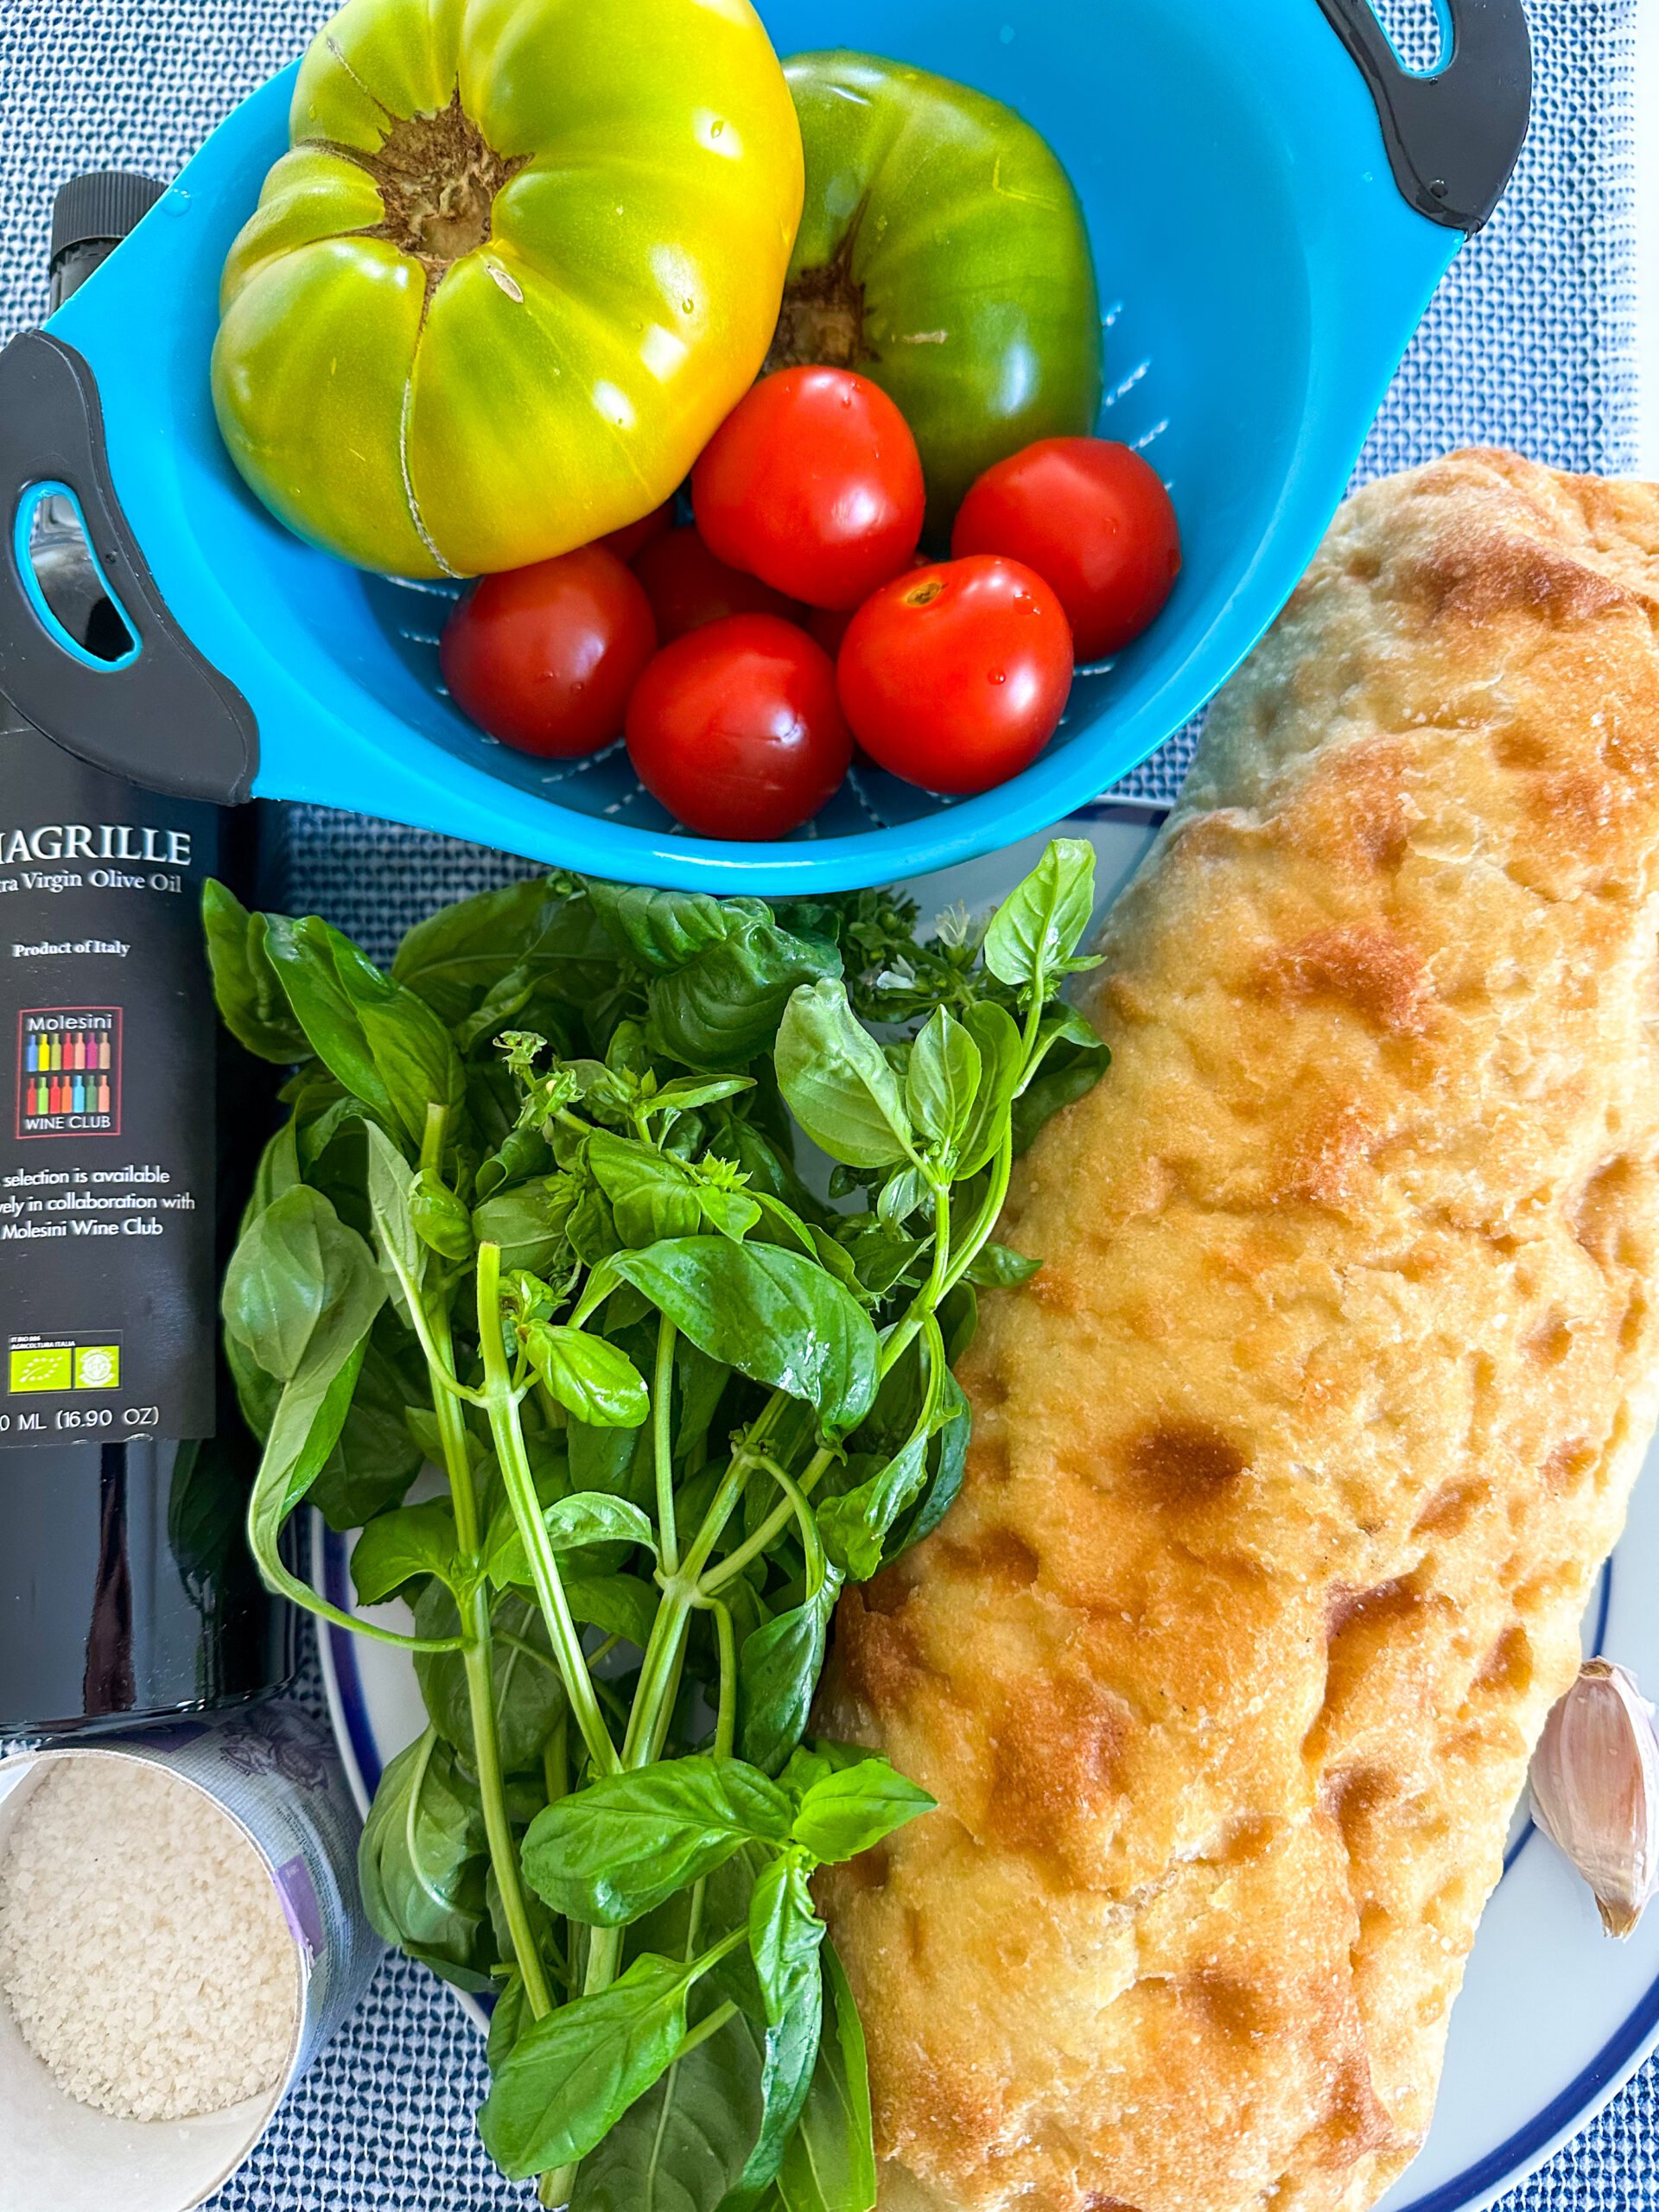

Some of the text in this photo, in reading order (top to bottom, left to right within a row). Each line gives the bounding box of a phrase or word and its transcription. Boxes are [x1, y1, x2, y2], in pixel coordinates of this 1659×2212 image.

[0, 823, 192, 866] AGRILLE
[20, 869, 83, 893] Virgin
[88, 868, 145, 889] Olive
[149, 873, 182, 893] Oil
[12, 940, 130, 957] Product of Italy
[28, 1014, 112, 1032] Molesini
[24, 1116, 111, 1130] WINE CLUB
[3, 1165, 171, 1187] selection is available
[27, 1196, 43, 1211] in
[46, 1191, 157, 1211] collaboration
[160, 1192, 195, 1210] with
[1, 1217, 163, 1240] Molesini Wine Club
[17, 1413, 48, 1431] ML
[54, 1409, 113, 1430] (16.90
[122, 1406, 159, 1426] OZ)
